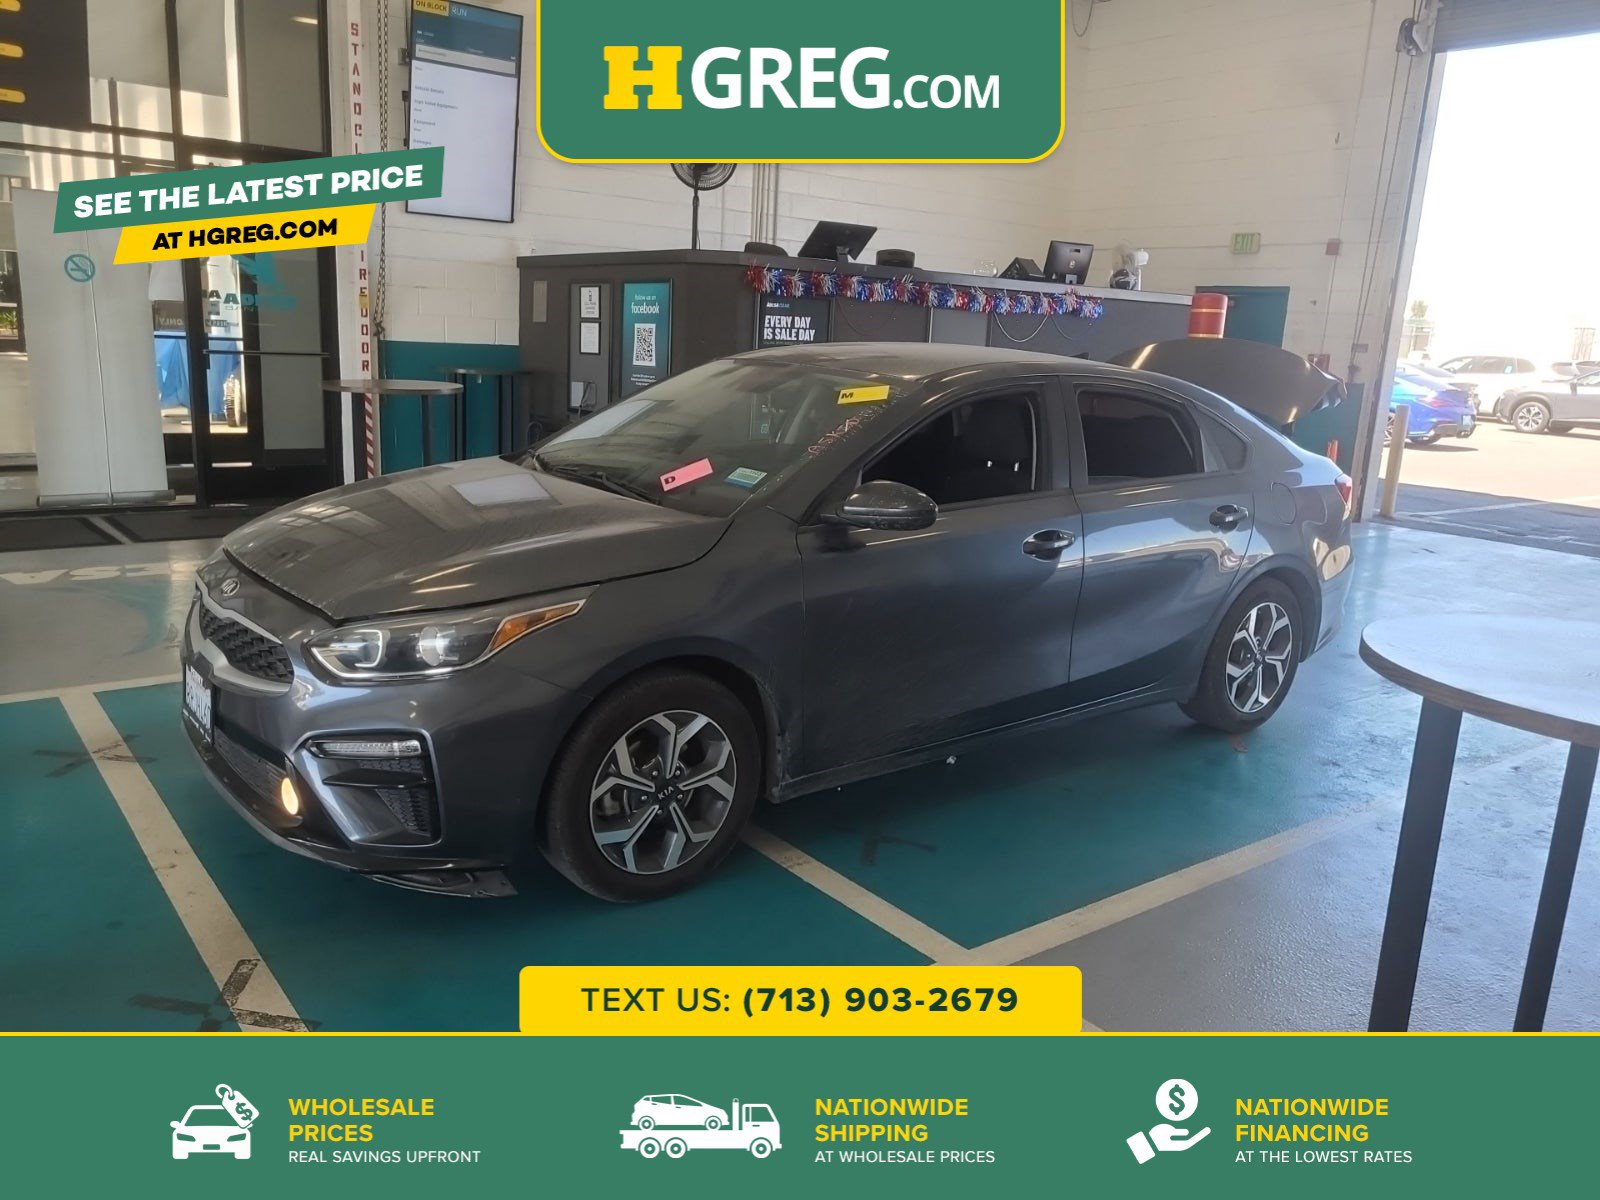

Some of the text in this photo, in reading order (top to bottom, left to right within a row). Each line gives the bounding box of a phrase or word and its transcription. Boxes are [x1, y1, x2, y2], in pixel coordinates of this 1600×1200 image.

[416, 0, 448, 12] ON BLOCK
[452, 6, 467, 17] RUN
[351, 22, 363, 117] STAND
[1233, 232, 1257, 252] EXIT
[631, 302, 660, 314] facebook
[764, 315, 811, 329] EVERY DAY
[763, 328, 816, 341] IS SALE DAY
[657, 786, 675, 800] KIA
